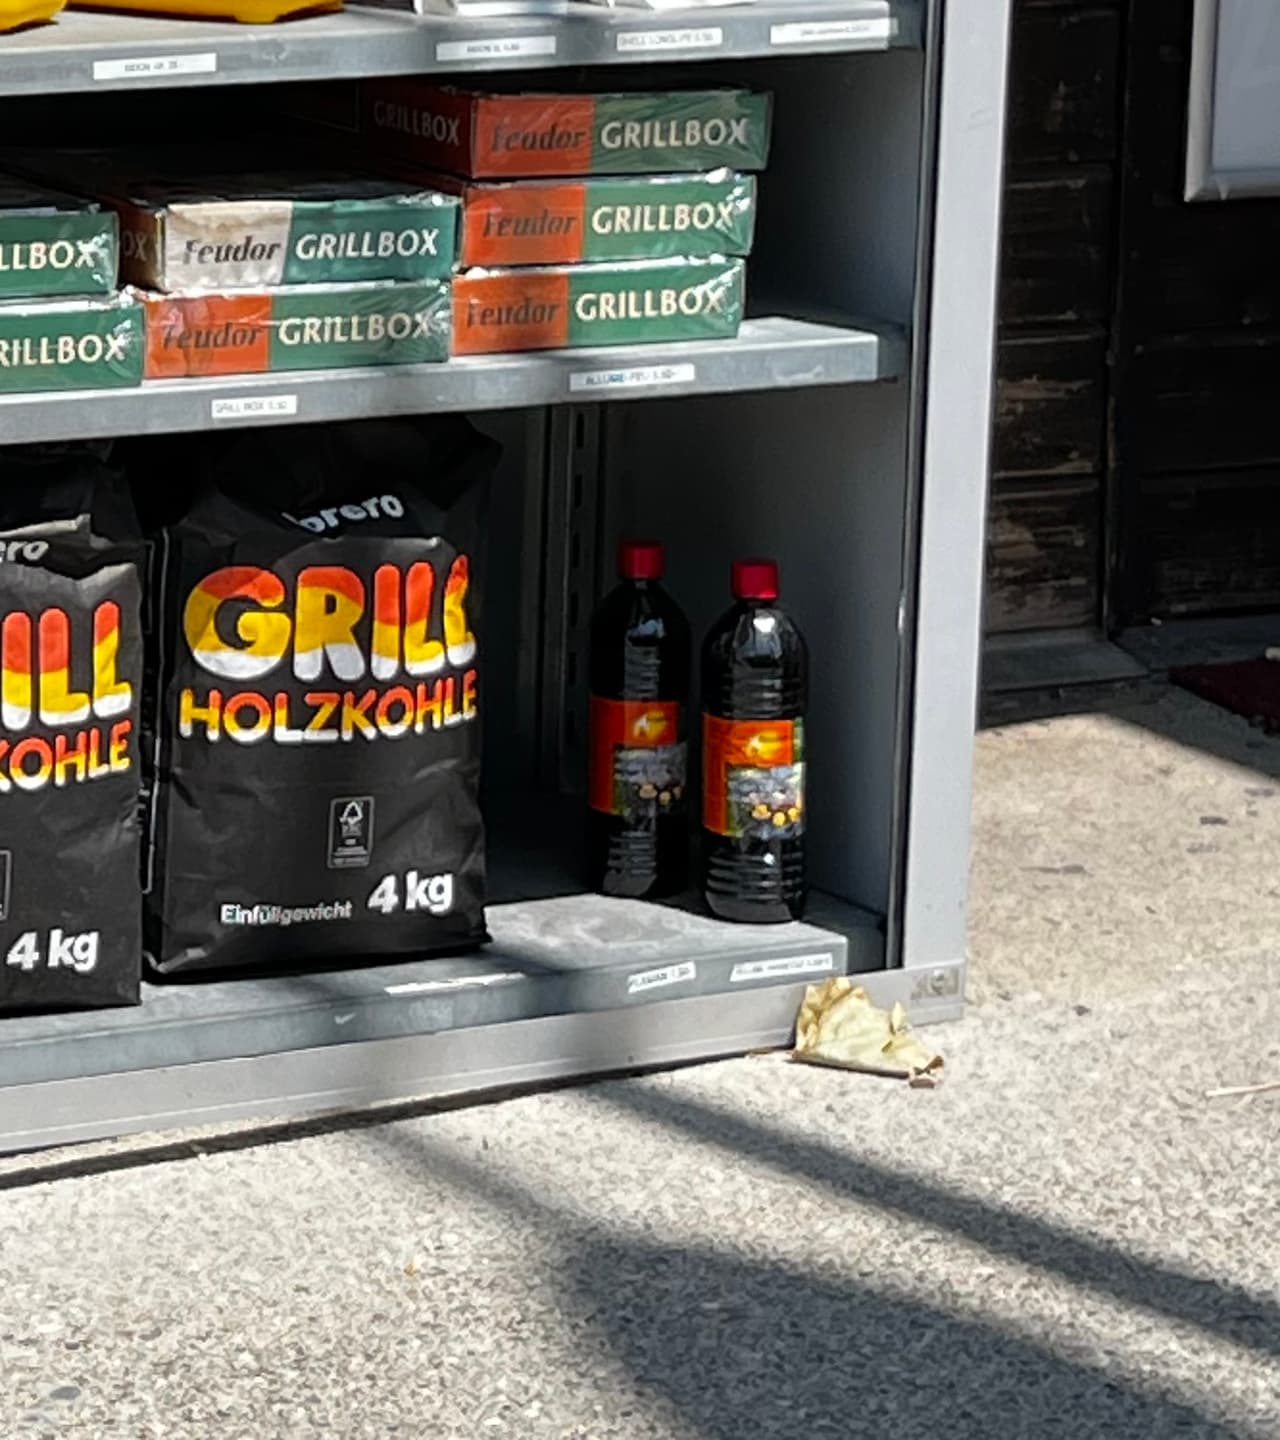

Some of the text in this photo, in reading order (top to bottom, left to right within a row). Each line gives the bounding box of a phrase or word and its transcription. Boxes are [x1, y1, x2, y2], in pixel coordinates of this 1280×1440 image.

[373, 98, 461, 147] GRILLBOX
[490, 117, 747, 152] Feudor GRILLBOX
[481, 200, 736, 238] Feudor GRILLBOX
[183, 234, 281, 266] Feudor
[294, 227, 439, 260] GRILLBOX
[466, 284, 725, 328] Feudor GRILLBOX
[161, 310, 435, 351] Feudor GRILLBOX
[183, 554, 477, 682] GRILL
[179, 670, 478, 745] HOLZKOHLE
[221, 871, 453, 926] Einfüllgewicht 4 kg
[6, 932, 39, 969] 4
[48, 927, 99, 972] kg
